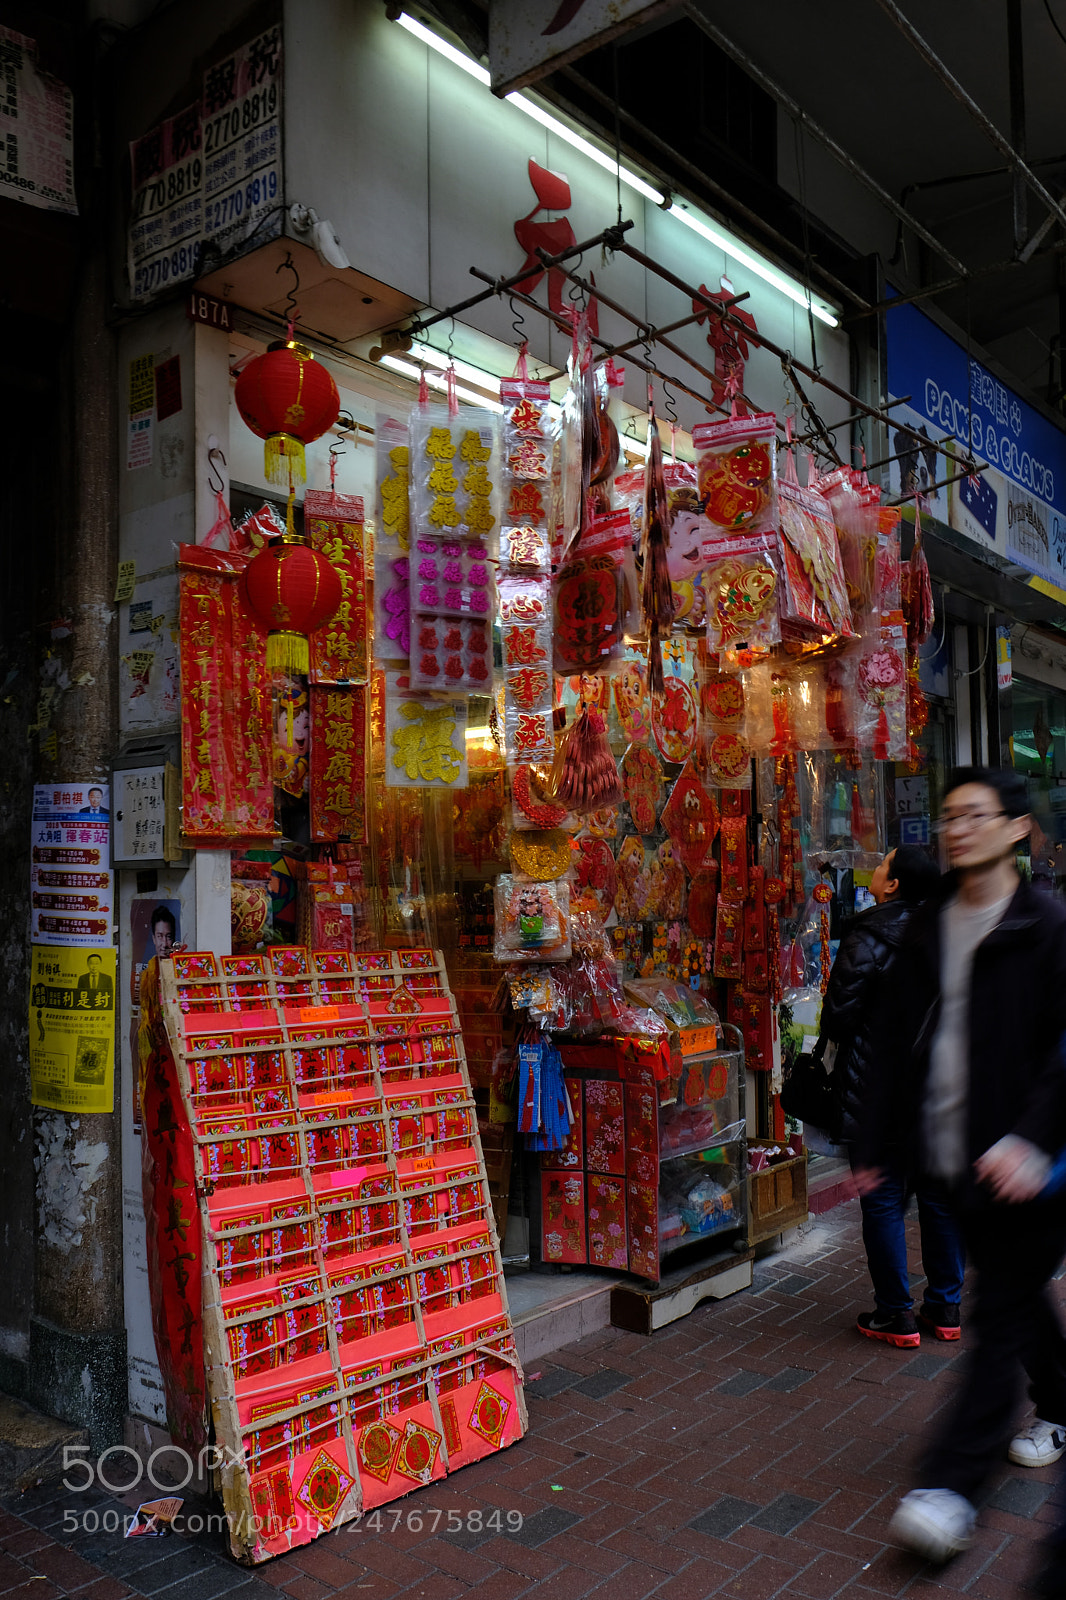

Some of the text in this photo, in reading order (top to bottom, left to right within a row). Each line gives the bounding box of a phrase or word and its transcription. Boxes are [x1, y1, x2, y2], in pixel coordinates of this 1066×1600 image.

[205, 84, 278, 153] 2770 8819
[168, 158, 202, 202] 8819
[214, 196, 244, 229] 2770
[245, 171, 278, 210] 8819
[142, 257, 169, 292] 2770
[191, 294, 230, 328] 187A
[925, 377, 1055, 503] PAWS & CLAWS
[323, 693, 356, 815] 財源廣進
[38, 829, 108, 844] 大角咀 揮春站
[62, 991, 111, 1009] 利是封
